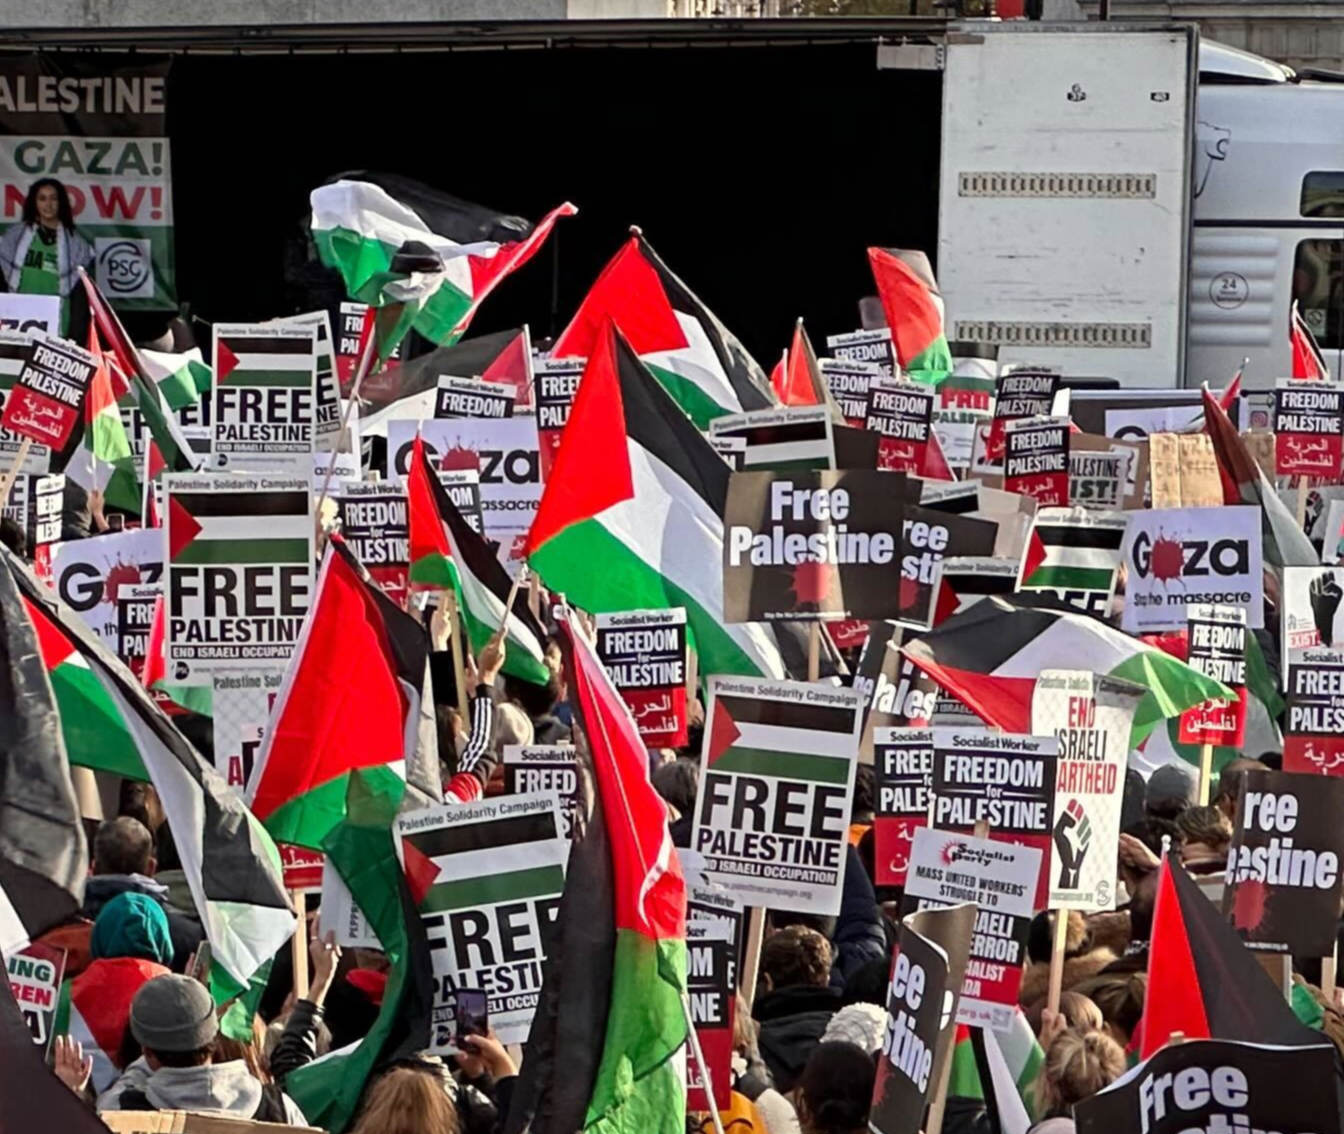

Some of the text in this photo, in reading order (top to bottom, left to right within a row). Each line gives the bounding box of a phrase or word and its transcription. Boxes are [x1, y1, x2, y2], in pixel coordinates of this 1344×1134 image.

[13, 139, 165, 176] GAZA!
[5, 184, 164, 219] NW!
[109, 258, 140, 278] PSC
[33, 344, 90, 382] FREEDOM
[21, 369, 83, 404] PALESTINE
[1281, 390, 1341, 411] FREEDOM
[216, 388, 311, 424] FREE
[1277, 412, 1341, 433] PALESTINE
[215, 423, 311, 443] PALESTINE
[168, 477, 309, 490] Palestine Solidarity Campaign
[771, 481, 849, 518] Free
[729, 524, 895, 567] Palestine
[1132, 528, 1250, 578] Gza
[169, 566, 309, 618] FREE
[1167, 590, 1251, 605] massacre
[605, 627, 679, 655] FREEDOM
[714, 680, 858, 707] Palestine Solidarity Campaign
[1068, 696, 1097, 729] END
[943, 755, 1044, 788] FREEDOM
[398, 798, 553, 832] Palestine Solidarity Campaign
[699, 772, 848, 841] FREE
[936, 797, 1048, 830] PALESTINE
[697, 827, 842, 869] PALESTINE
[718, 861, 837, 886] ISRAELI OCCUPATION
[915, 864, 944, 882] MASS
[945, 870, 976, 888] UNITED
[985, 893, 998, 906] TO
[1140, 1066, 1248, 1134] Free
